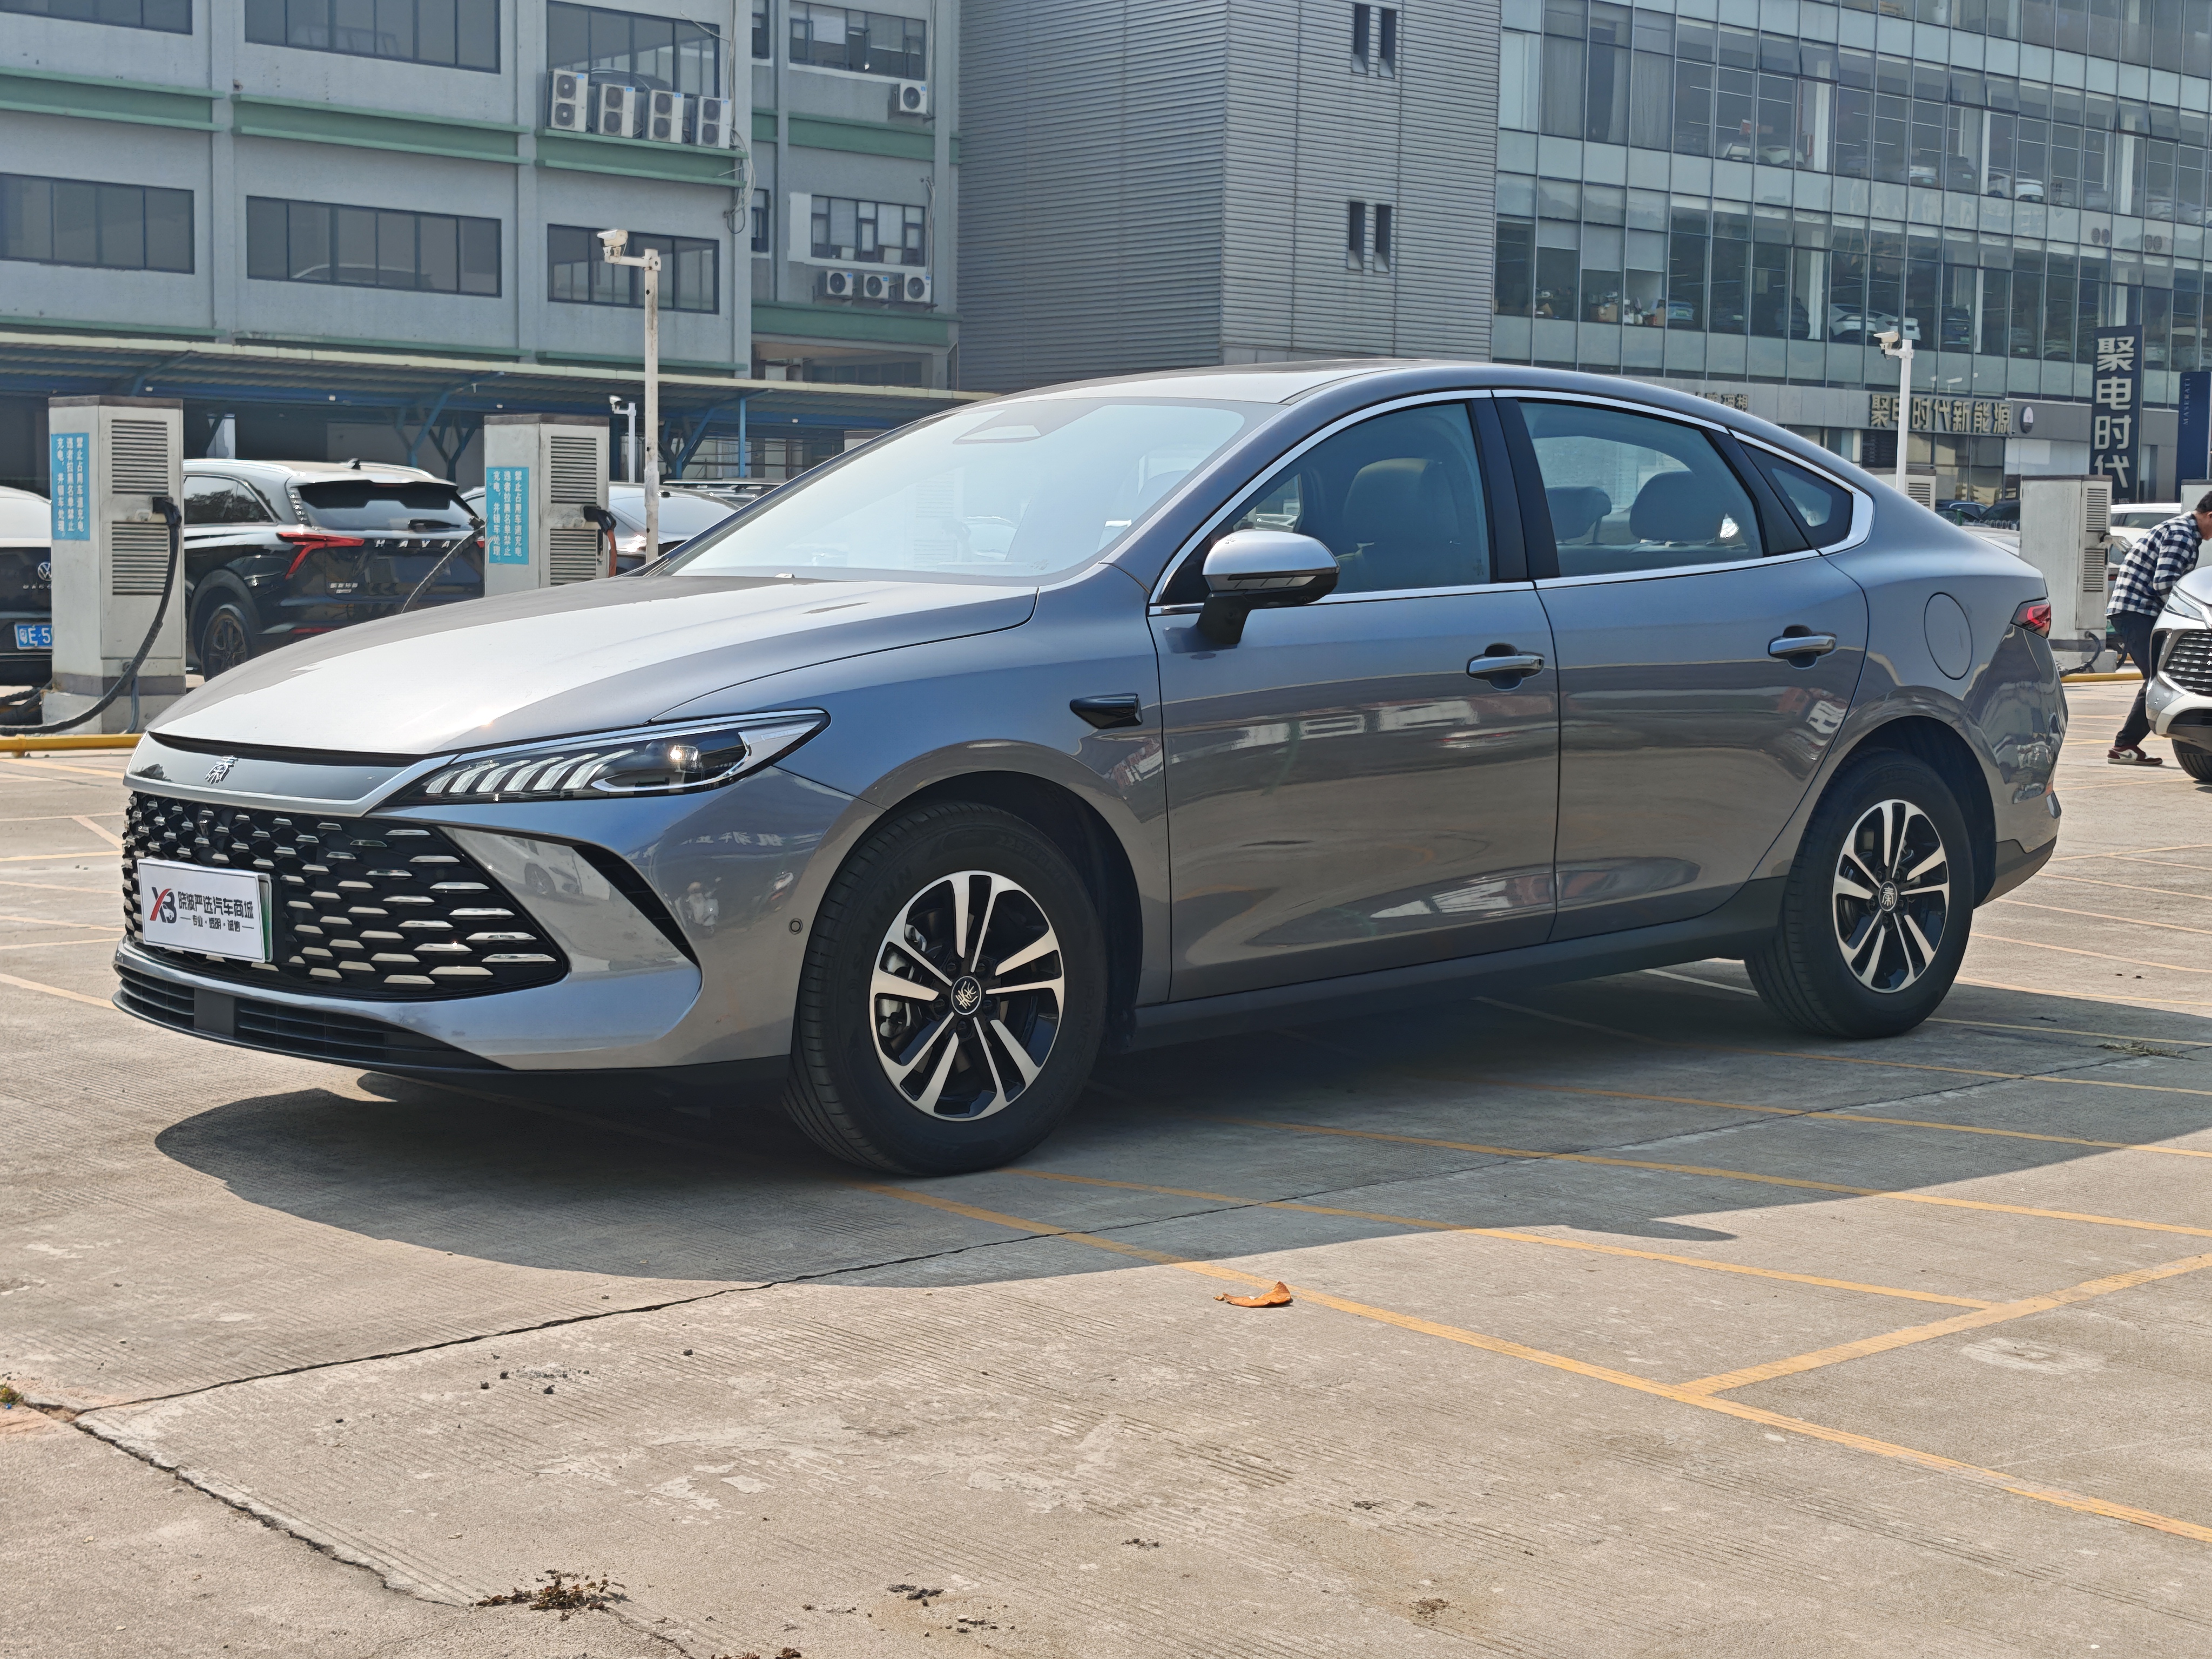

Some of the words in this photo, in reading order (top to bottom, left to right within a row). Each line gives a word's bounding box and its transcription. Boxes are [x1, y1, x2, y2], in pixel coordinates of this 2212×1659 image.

[2094, 336, 2135, 488] 聚电时代
[2182, 378, 2191, 426] MASERATI
[375, 539, 450, 548] HAVA
